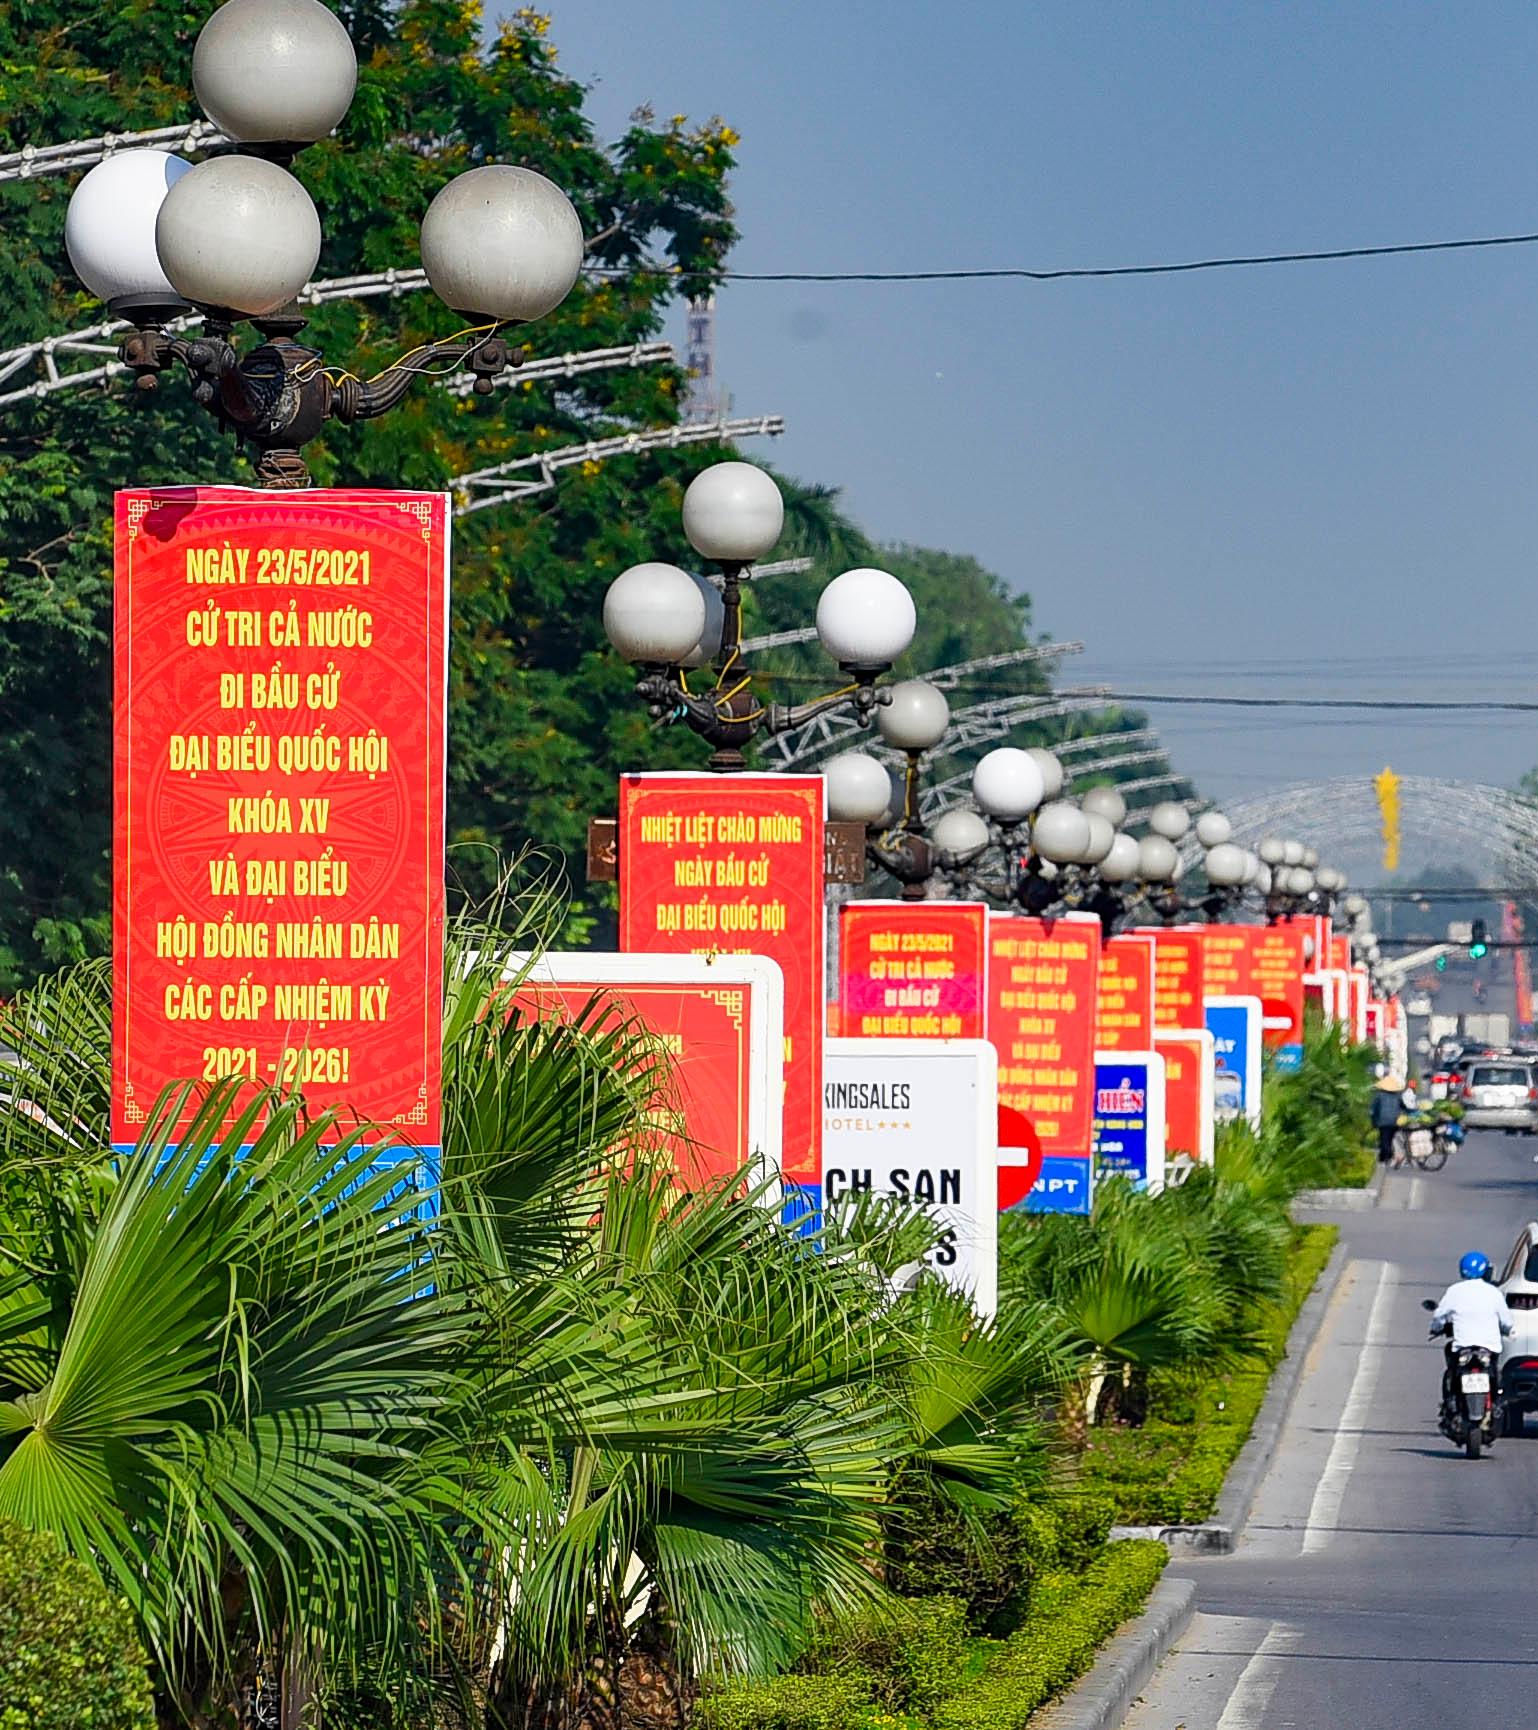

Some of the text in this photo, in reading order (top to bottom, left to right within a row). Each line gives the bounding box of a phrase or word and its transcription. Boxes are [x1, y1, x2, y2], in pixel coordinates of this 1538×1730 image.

[187, 541, 369, 585] NGÀY 23/5/2021
[187, 599, 372, 647] CỬ TRI CẢ NƯỚC
[220, 661, 340, 709] ĐI BẦU CỬ
[170, 721, 387, 780] ĐẠI BIỂU QUỐC HỘI
[229, 790, 329, 833] KHÓA XV
[641, 811, 801, 848] NHIỆT LIỆT CHÀO MỪNG
[209, 846, 347, 904] VÀ ĐẠI BIỂU
[675, 855, 713, 886] NGÀY
[748, 853, 769, 886] CỬ
[657, 894, 785, 936] ĐẠI BIỂU QUỐC HỘI
[157, 911, 399, 965] HỘI ĐỒNG NHÂN DÂN
[165, 972, 389, 1030] CÁC CẤP NHIỆM KỲ
[203, 1047, 349, 1084] 2021 - 2026!
[1032, 1180, 1079, 1194] NPT
